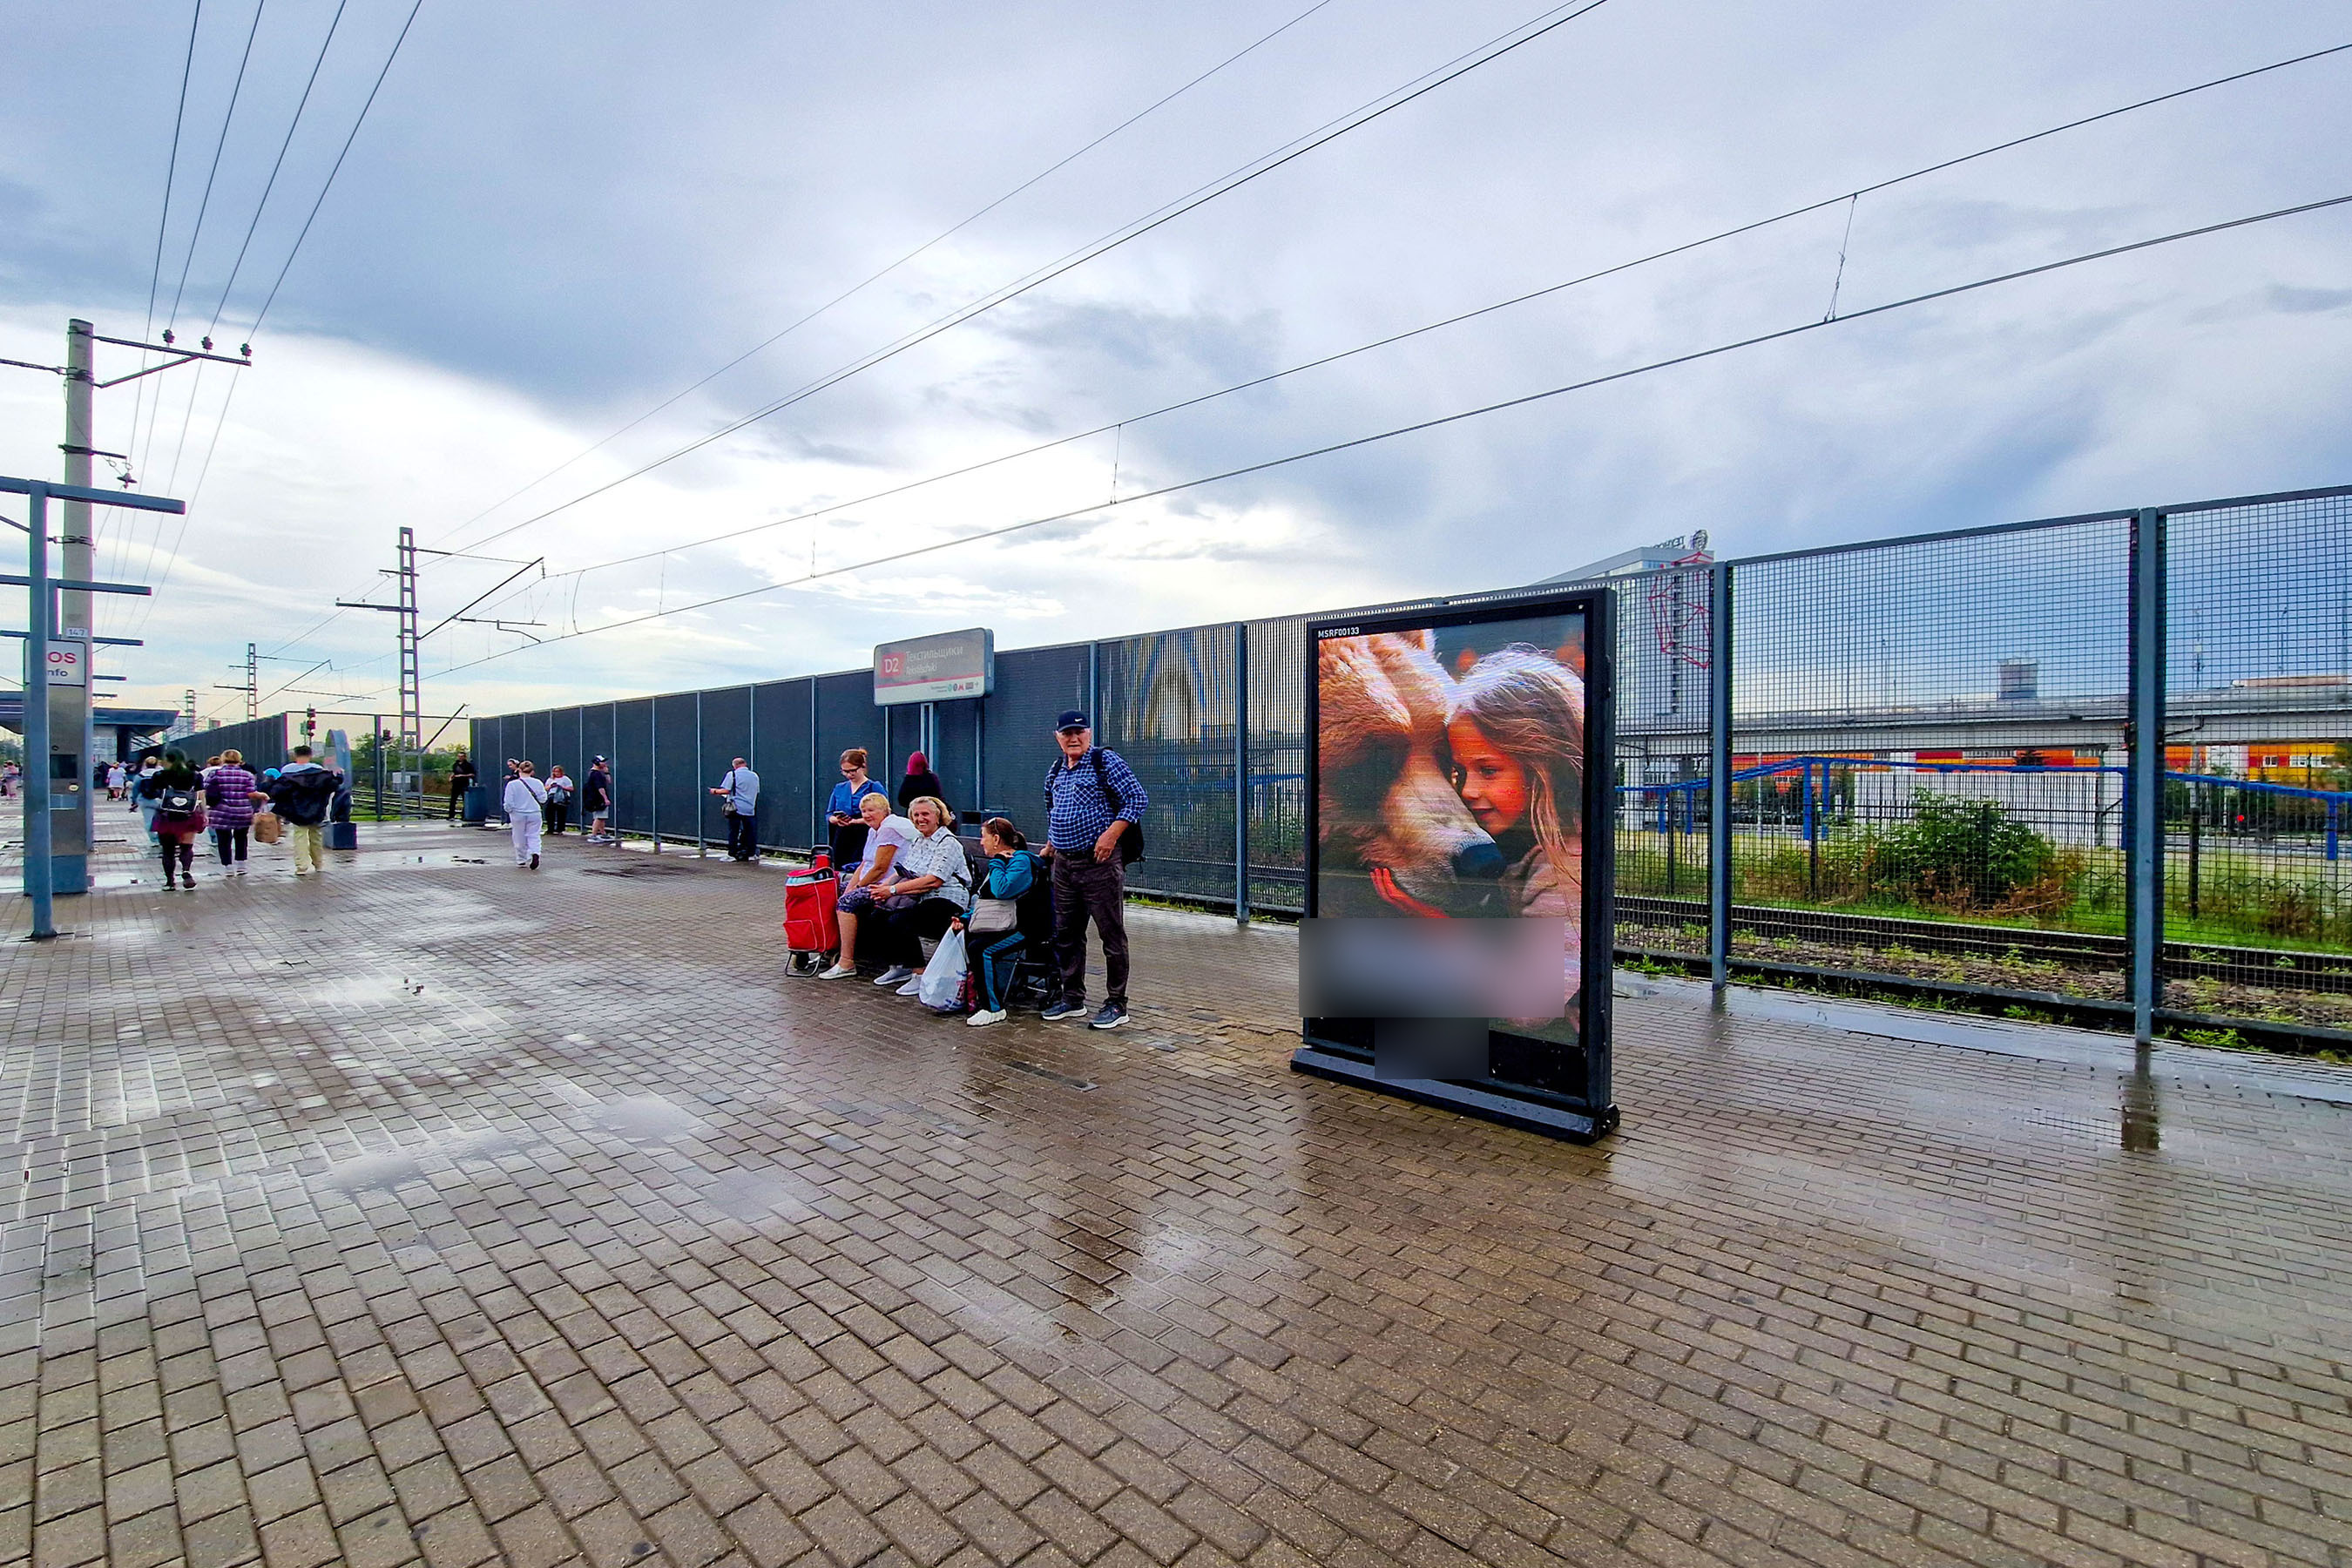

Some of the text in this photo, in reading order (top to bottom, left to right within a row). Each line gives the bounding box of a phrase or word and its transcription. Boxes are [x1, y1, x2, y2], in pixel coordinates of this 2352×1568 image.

[1317, 626, 1360, 638] MSRF00133
[47, 651, 78, 664] OS
[884, 657, 900, 673] D2
[47, 668, 69, 677] nfo
